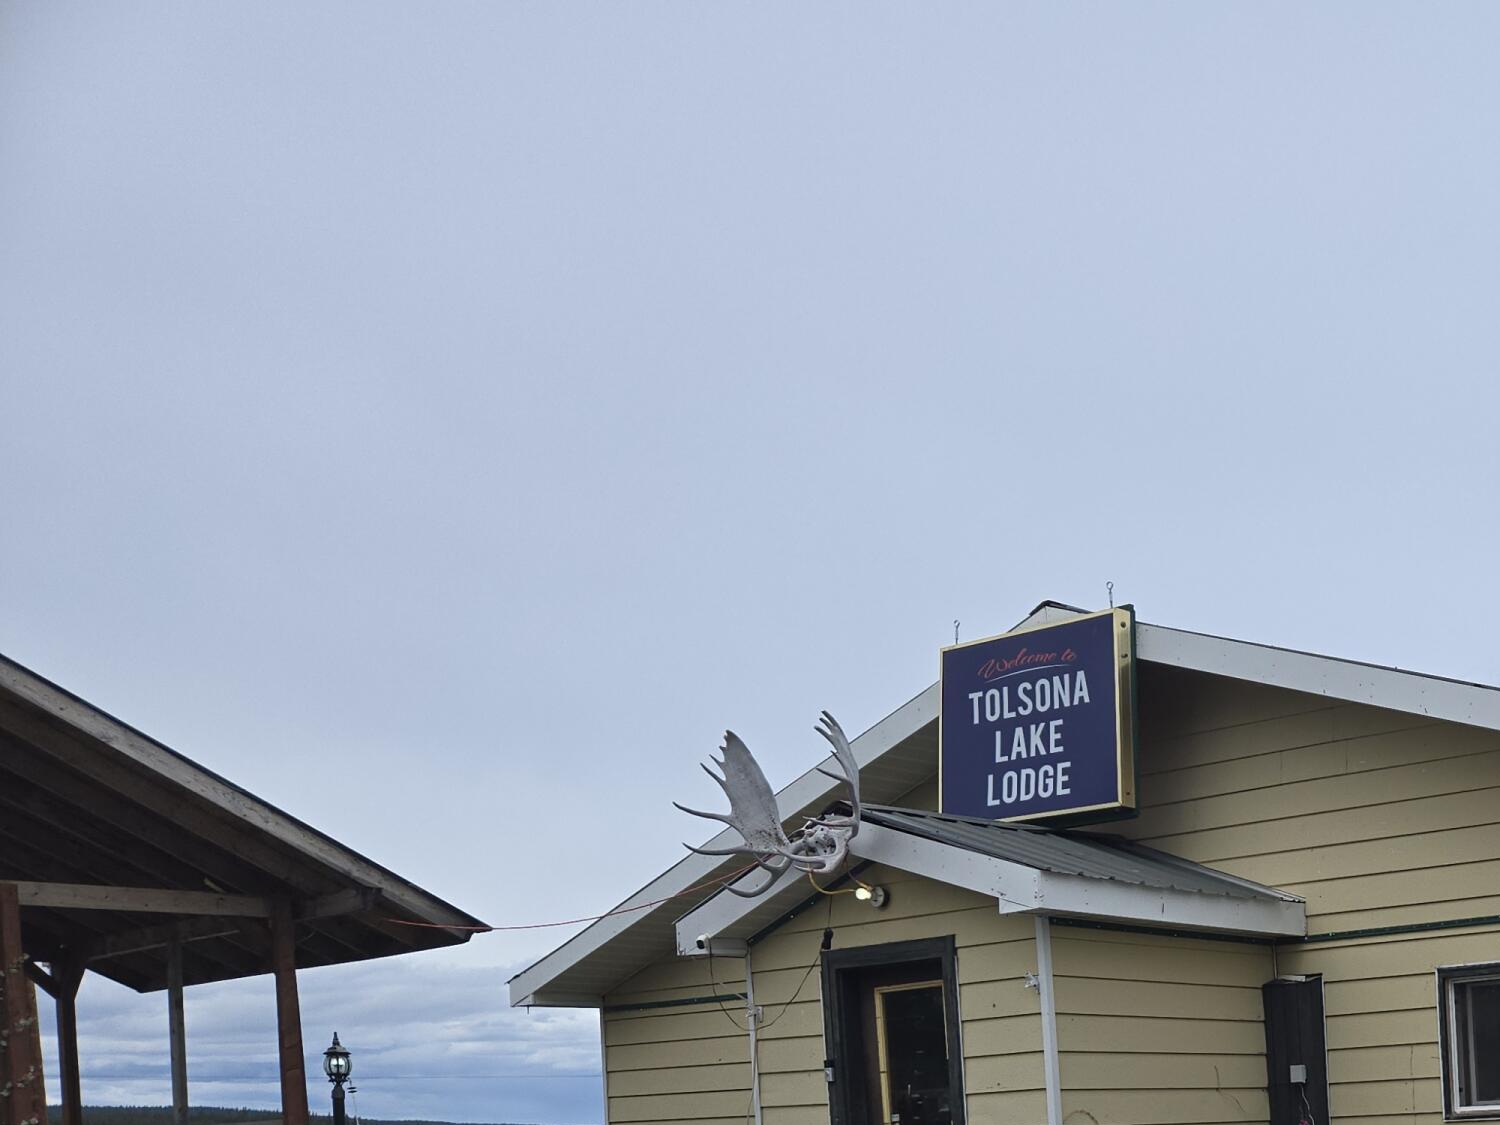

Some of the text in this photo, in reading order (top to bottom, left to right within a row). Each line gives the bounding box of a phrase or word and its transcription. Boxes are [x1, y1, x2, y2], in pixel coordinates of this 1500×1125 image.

[977, 648, 1077, 678] Welcome to
[969, 670, 1090, 725] TOLSONA
[995, 719, 1064, 763] LAKE
[987, 761, 1071, 806] LODGE
